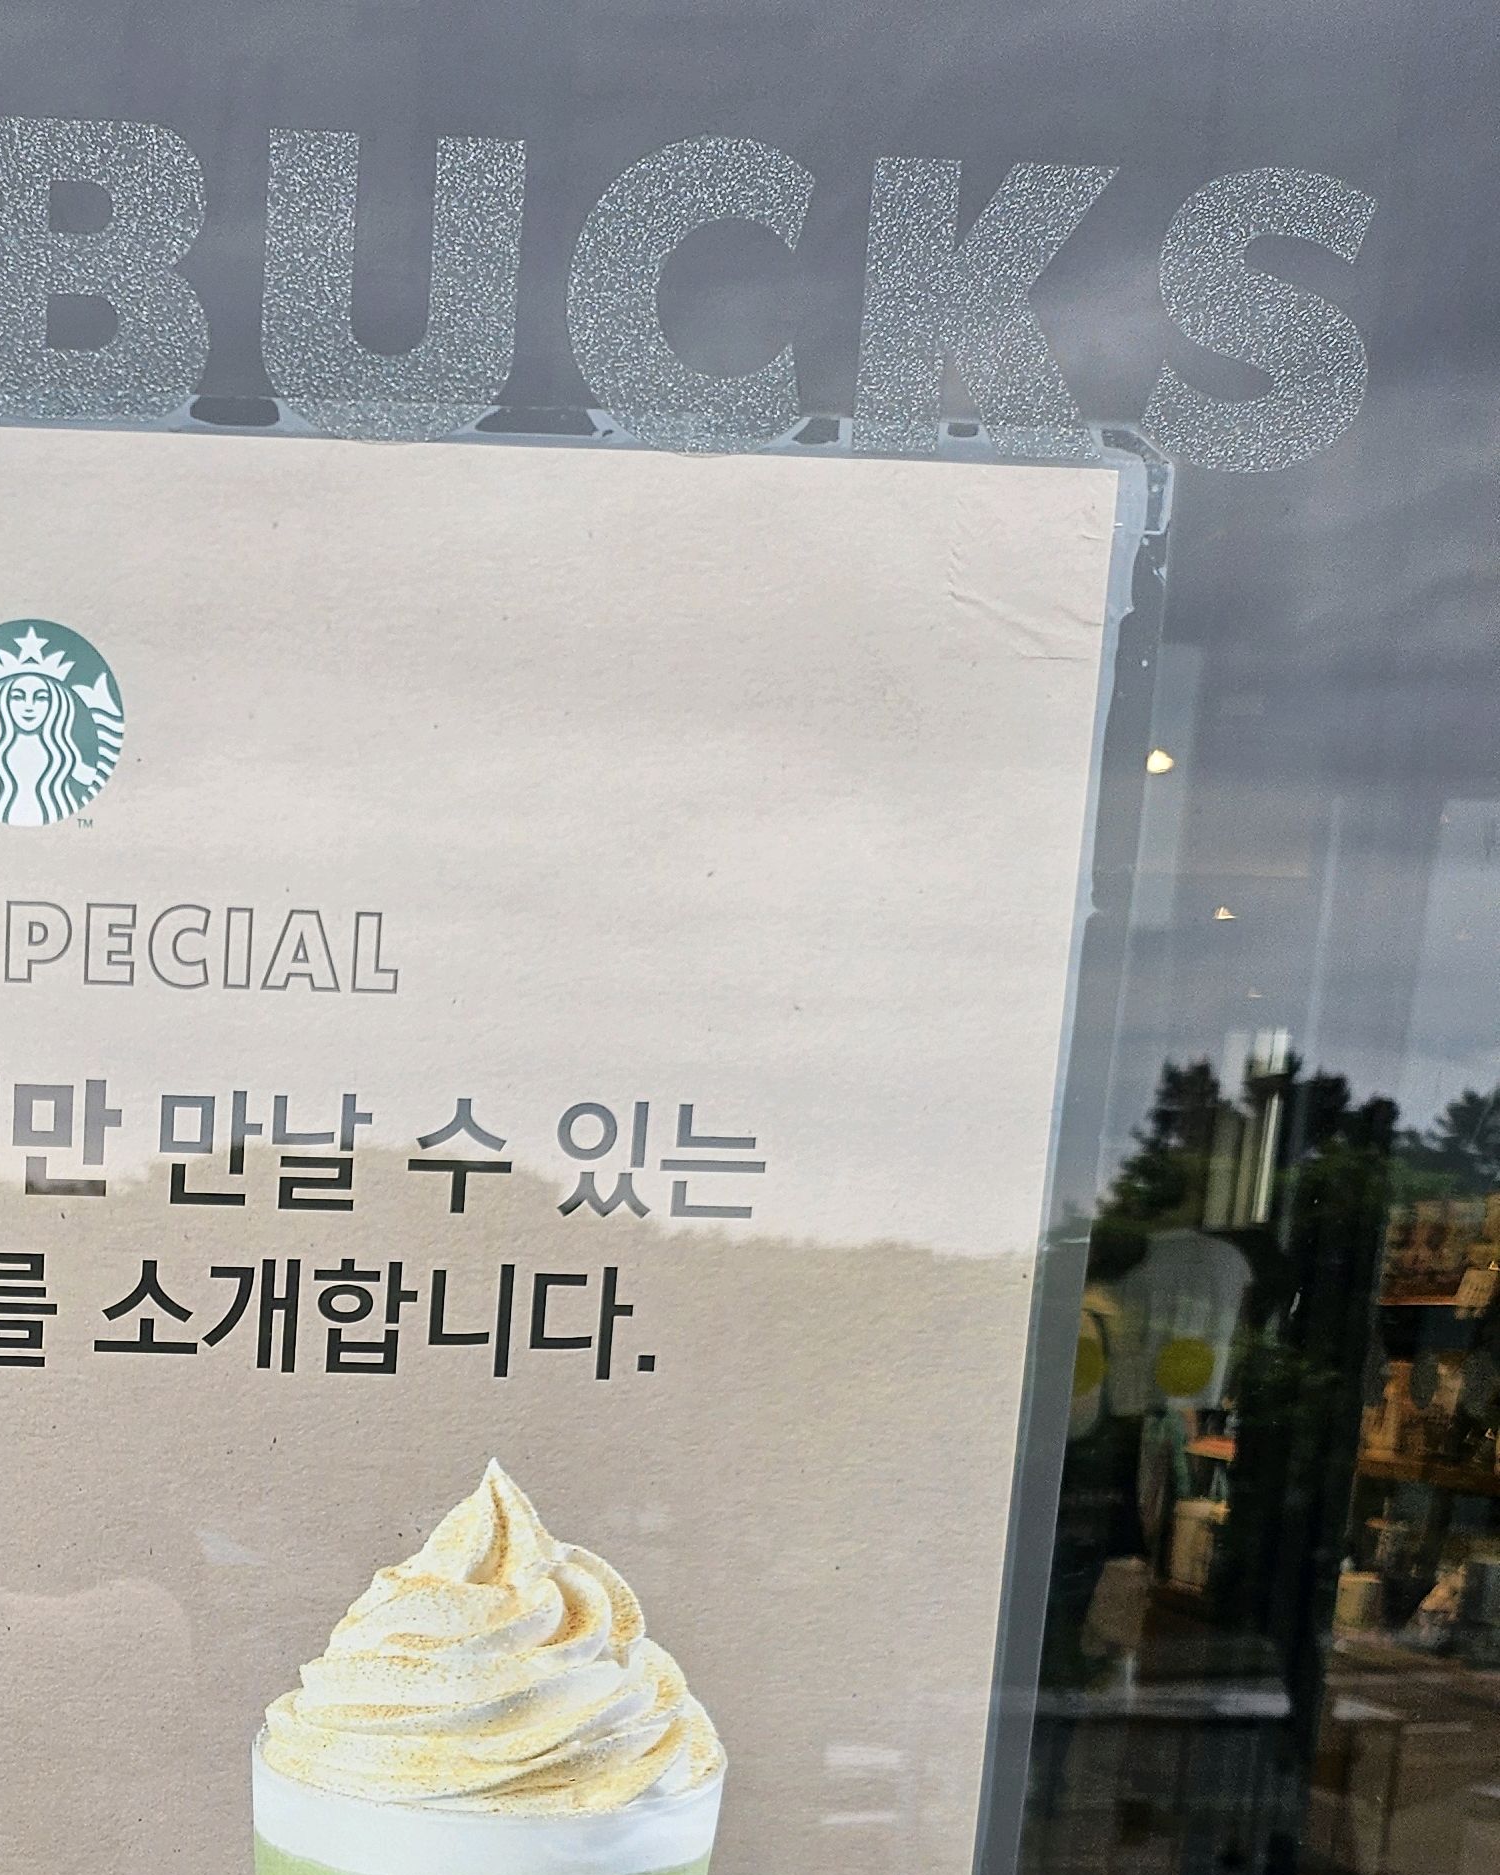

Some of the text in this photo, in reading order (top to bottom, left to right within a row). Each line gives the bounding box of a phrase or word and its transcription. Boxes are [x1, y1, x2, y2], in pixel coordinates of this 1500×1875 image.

[159, 1090, 373, 1212] 만날
[407, 1098, 513, 1214] 수
[557, 1101, 766, 1219] 있는
[93, 1258, 656, 1380] 소개합니다.
